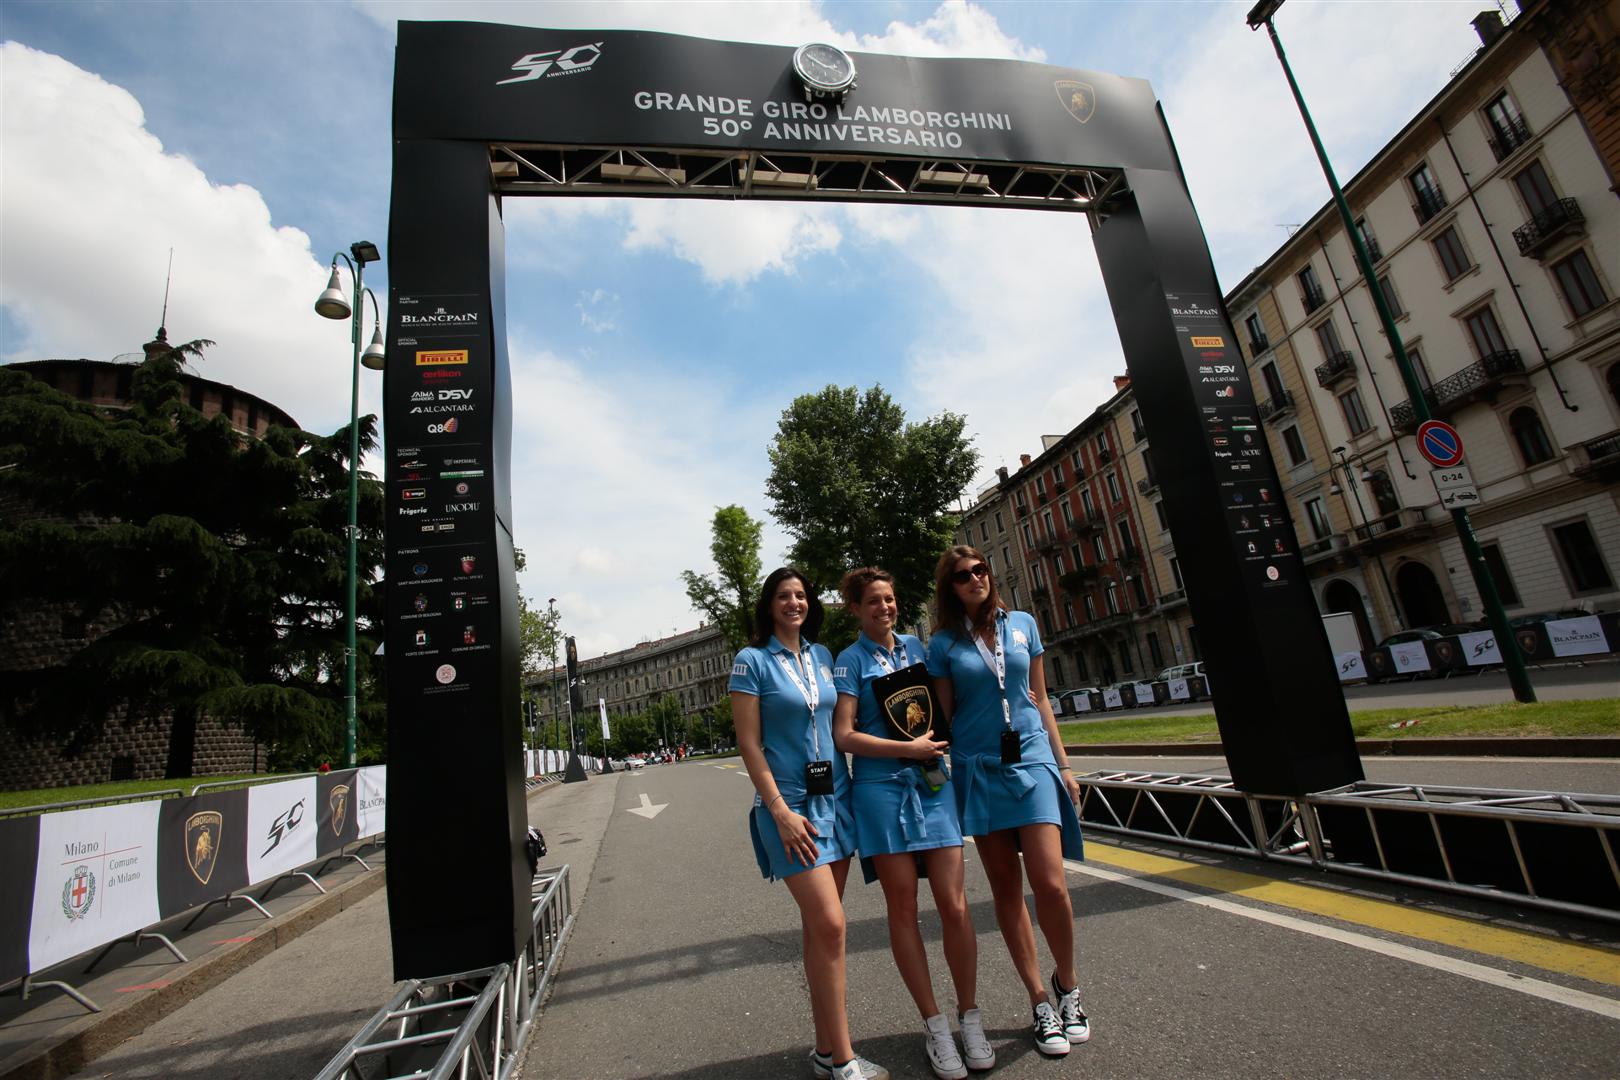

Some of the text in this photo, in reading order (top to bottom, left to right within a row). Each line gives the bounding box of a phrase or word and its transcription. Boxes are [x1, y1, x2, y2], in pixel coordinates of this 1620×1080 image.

[495, 41, 604, 85] 50
[546, 66, 592, 78] ANNIVERSARIO
[634, 91, 1012, 130] GRANDE GIRO LAMBORGHINI
[763, 122, 962, 149] ANNIVERSARIO
[1172, 307, 1218, 316] BLANCPAIN
[401, 313, 478, 323] BLANCPAIN
[421, 352, 464, 363] PIRELLI
[1214, 365, 1235, 373] DSV
[438, 389, 473, 401] DSV
[423, 404, 474, 413] ALCANTARA
[427, 423, 444, 433] Q8
[399, 506, 428, 516] Frigerio
[1553, 632, 1600, 643] BLANCPAIN
[887, 688, 926, 708] LAMBORGHINI
[810, 766, 828, 774] STAFF
[360, 797, 386, 811] BLANCPA
[187, 814, 220, 831] LAMBORGHINI
[260, 797, 305, 859] 50
[64, 841, 99, 857] Milano
[109, 856, 138, 870] Comune
[108, 871, 141, 887] di Milano
